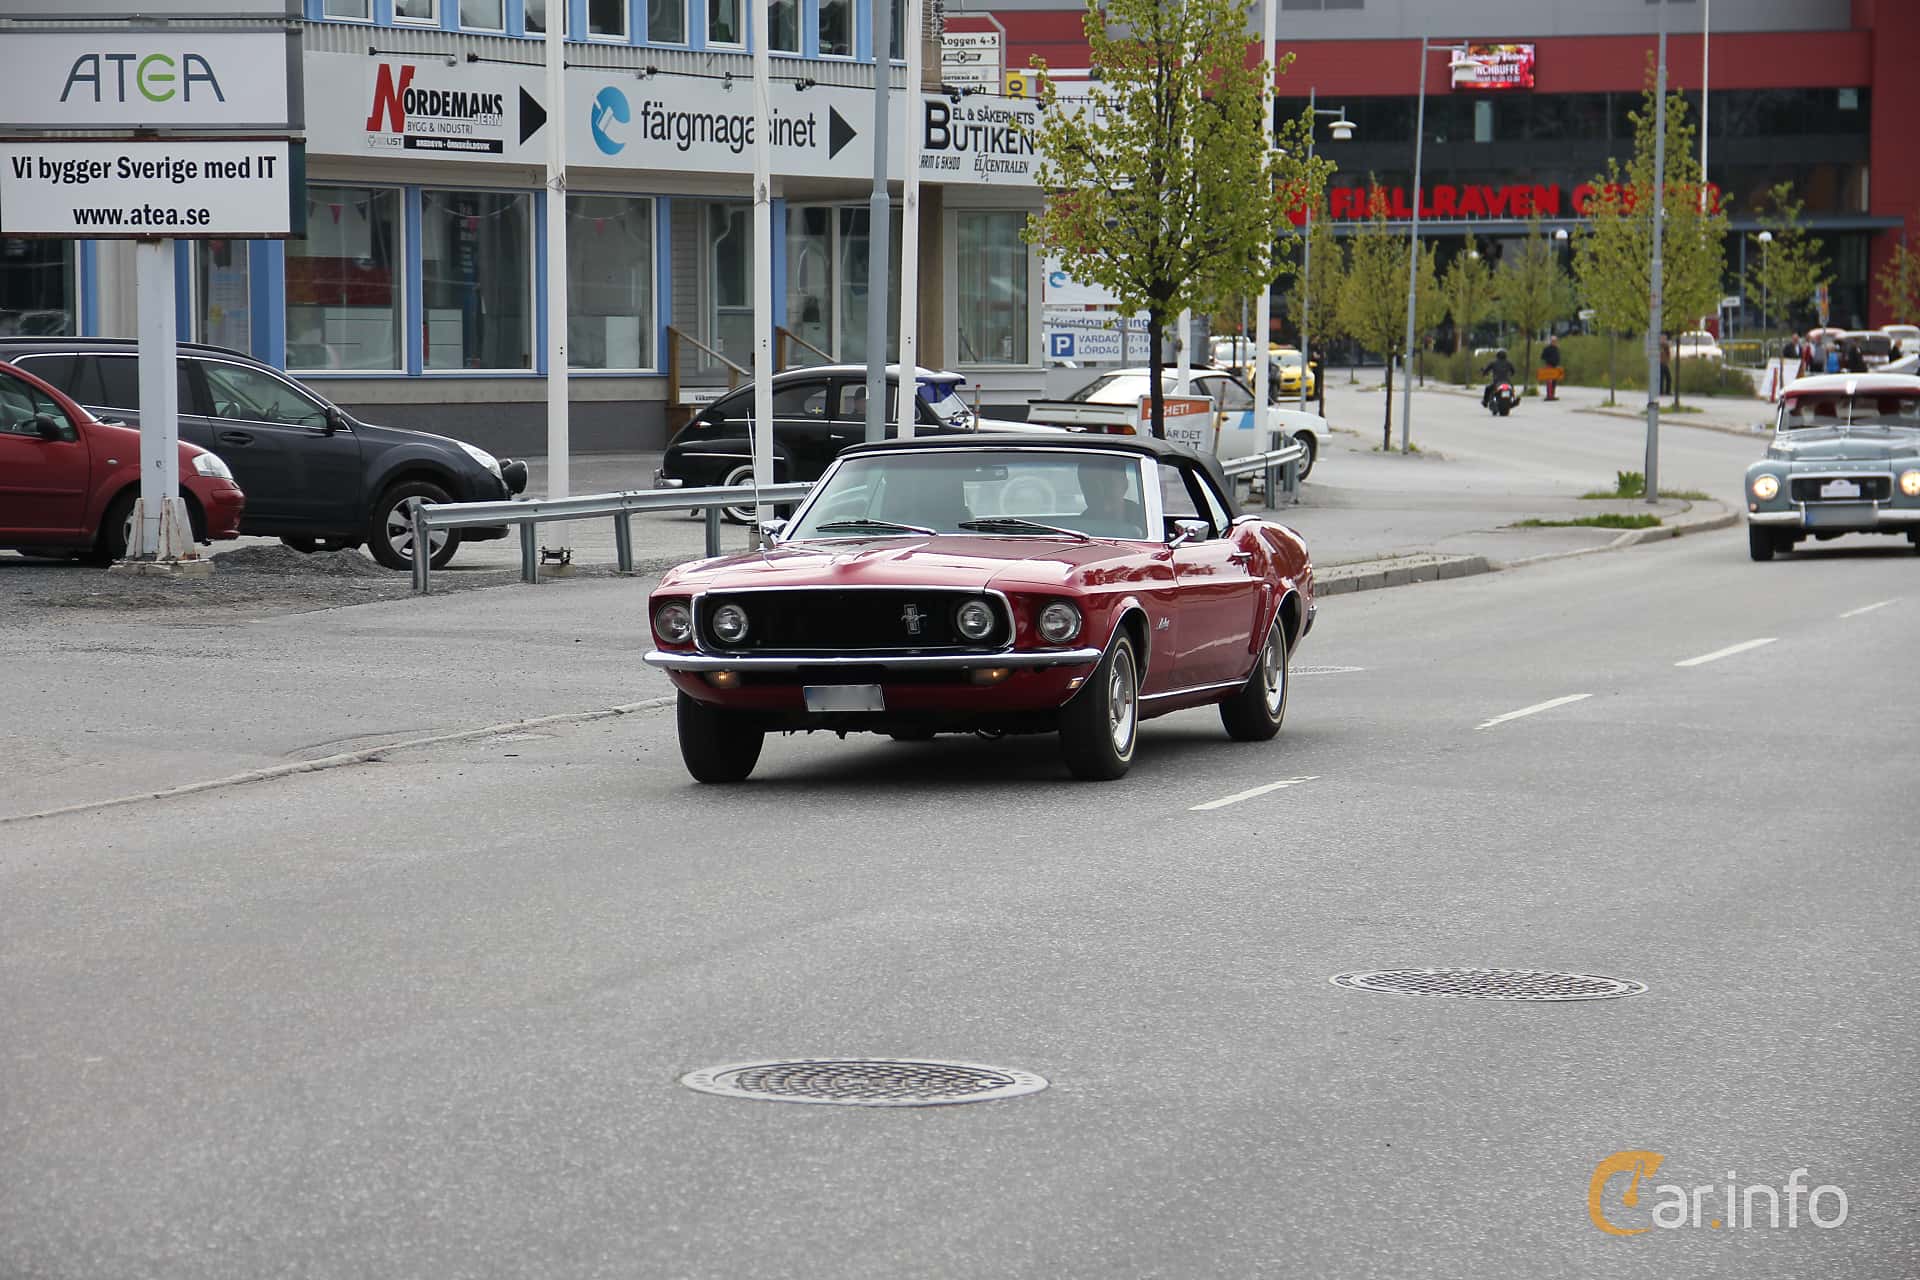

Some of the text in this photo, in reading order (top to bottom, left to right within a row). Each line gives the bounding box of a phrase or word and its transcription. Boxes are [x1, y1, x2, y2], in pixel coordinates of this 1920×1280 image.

[943, 36, 996, 46] Loggen 4-5
[60, 53, 225, 102] ATEA
[366, 64, 503, 133] NORDEMANS
[473, 112, 504, 126] JERN
[953, 107, 965, 120] EL
[968, 108, 975, 121] &
[407, 121, 473, 134] BYGG & INDUSTRI
[641, 100, 816, 154] färgmagainet
[924, 100, 1035, 155] BUTIKEN
[12, 156, 277, 184] Vi bygger Sverige med IT
[919, 155, 934, 169] ARM
[1331, 183, 1560, 219] FJÄLLRÄVEN
[73, 204, 210, 225] www.atea.se
